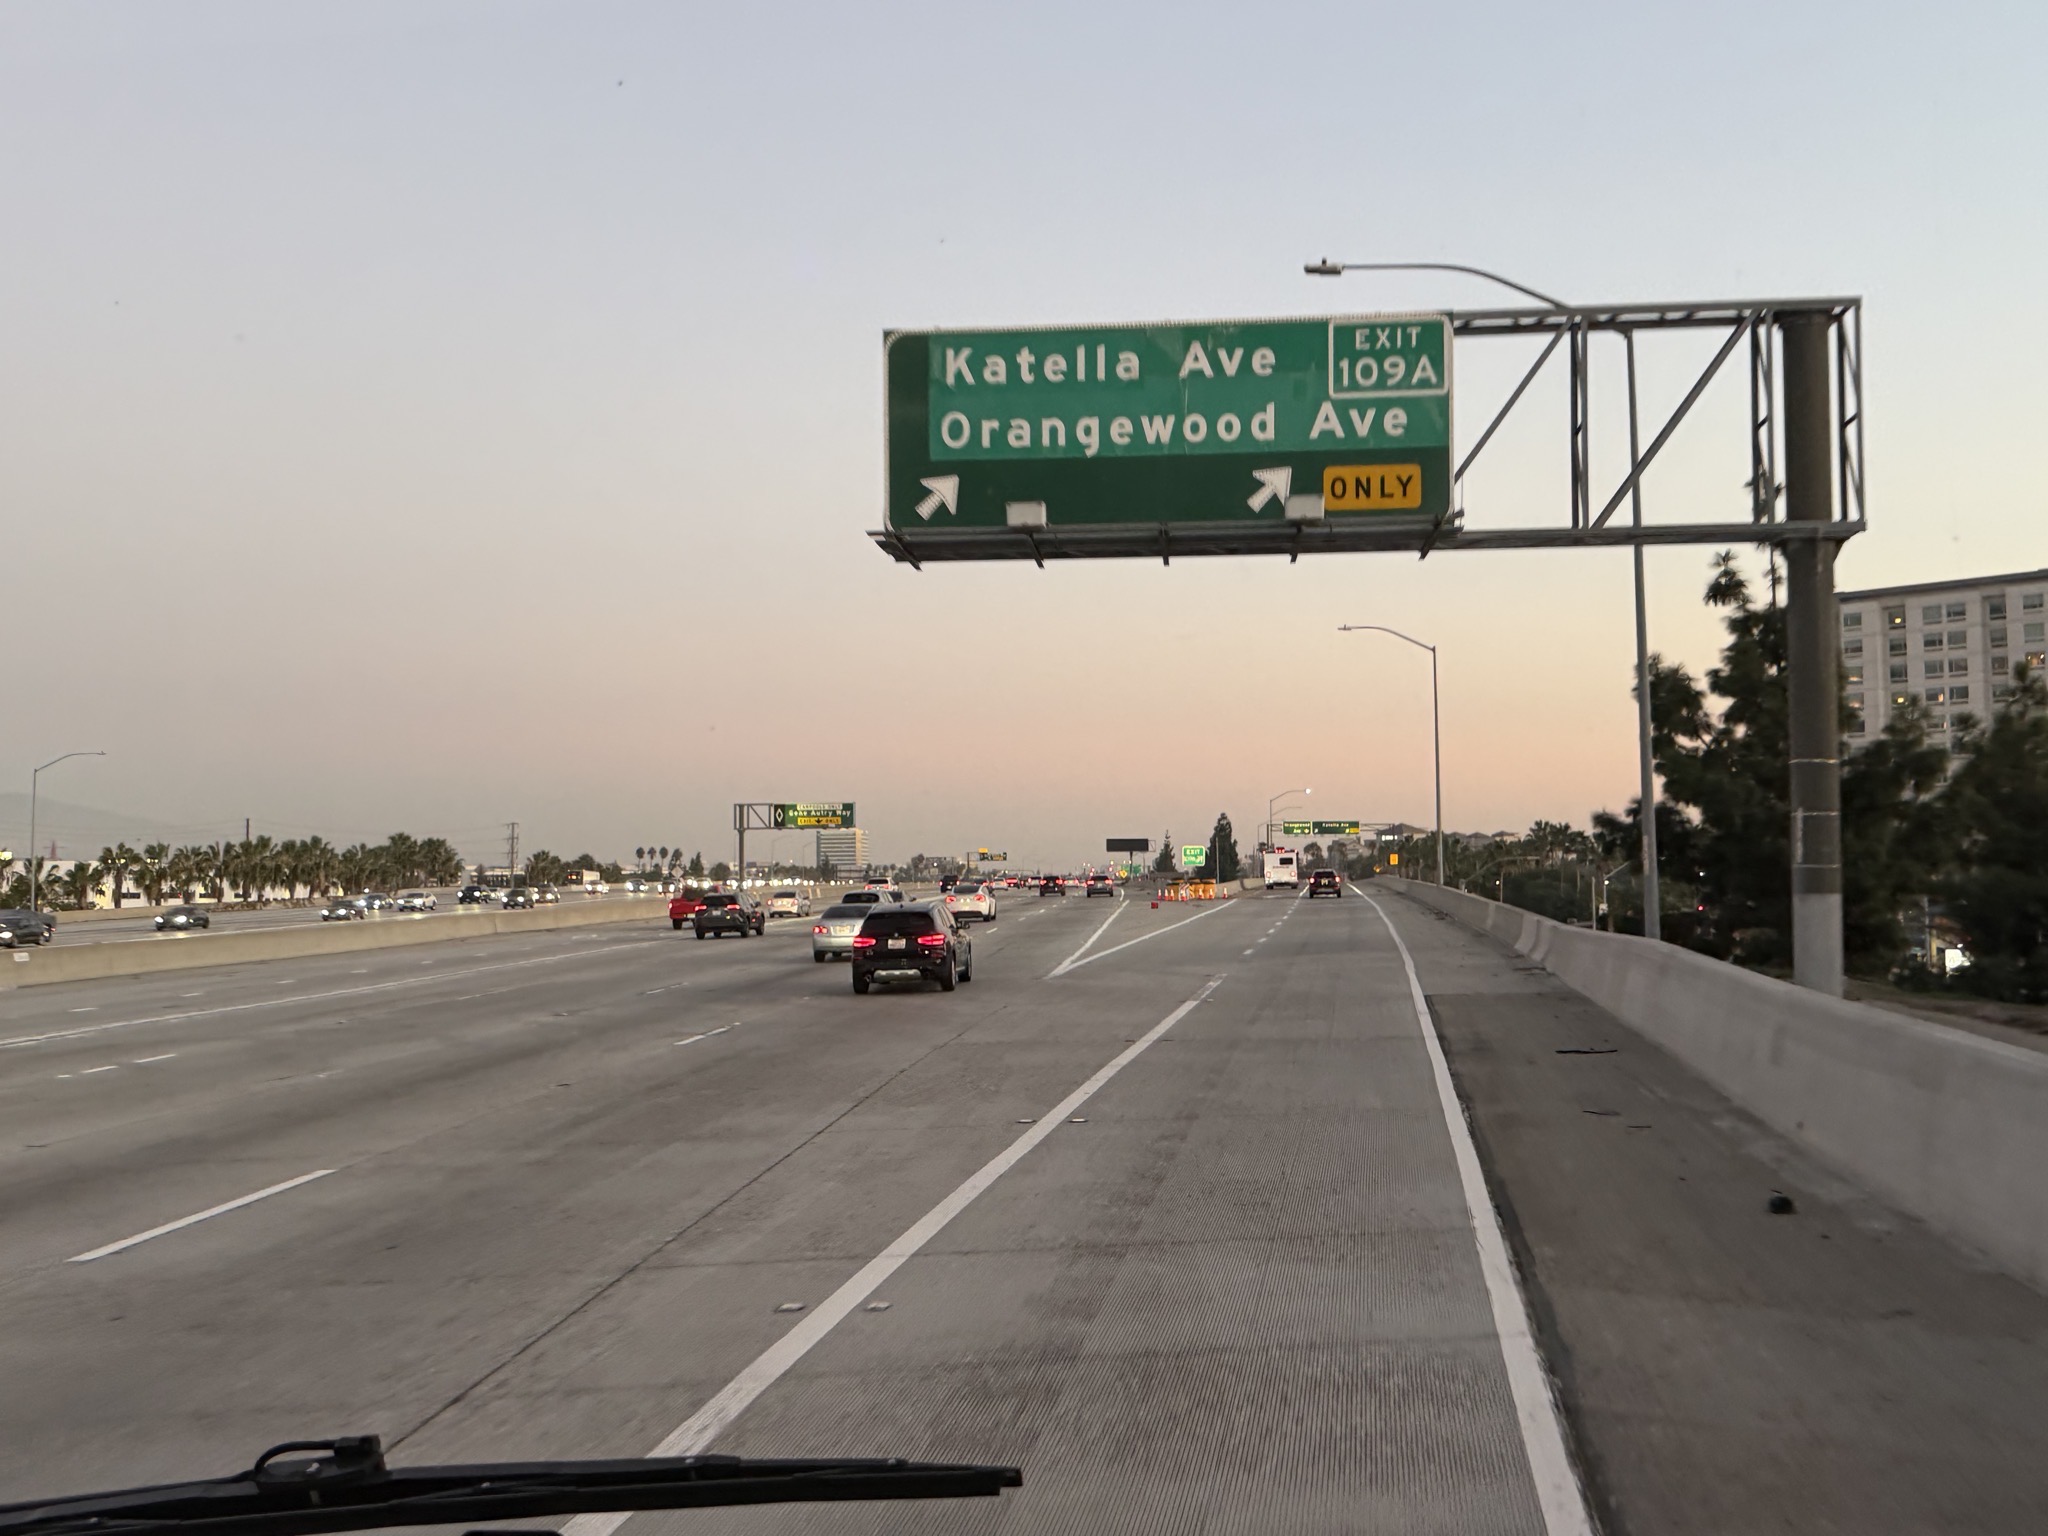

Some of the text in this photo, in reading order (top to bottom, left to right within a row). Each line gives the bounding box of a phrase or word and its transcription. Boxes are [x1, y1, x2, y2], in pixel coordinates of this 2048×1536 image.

[1354, 327, 1422, 351] EXIT
[944, 340, 1277, 387] Katella Ave
[1339, 355, 1438, 389] 109A
[940, 400, 1409, 457] Orangewood Ave
[1330, 474, 1415, 500] ONLY
[810, 809, 833, 817] Autry
[835, 809, 851, 817] Way
